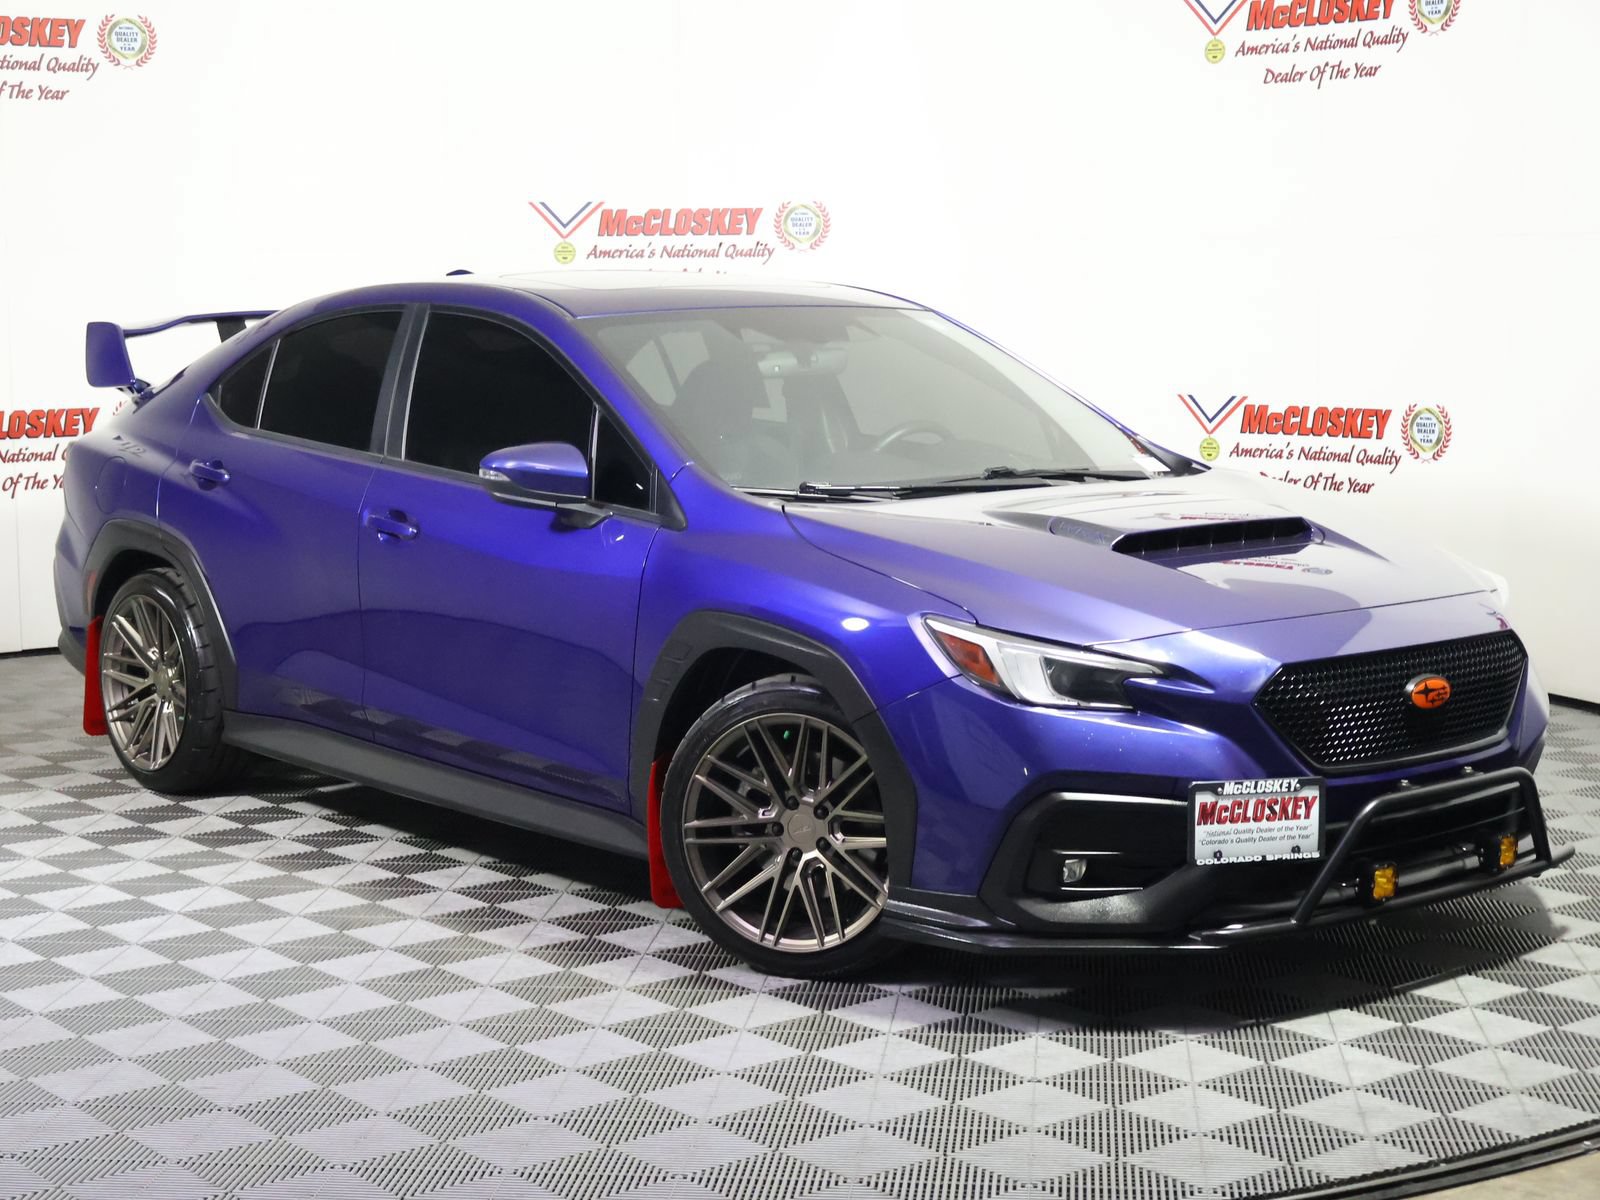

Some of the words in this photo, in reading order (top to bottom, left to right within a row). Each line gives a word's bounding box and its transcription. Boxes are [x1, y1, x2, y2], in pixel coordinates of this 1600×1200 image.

[1235, 35, 1300, 57] America's
[1304, 29, 1361, 53] National
[1363, 25, 1410, 53] Quality
[46, 54, 100, 81] Quality
[1263, 64, 1307, 84] Dealer
[1310, 61, 1329, 89] Of
[1329, 60, 1351, 80] The
[1354, 62, 1382, 79] Year
[8, 81, 34, 100] The
[37, 84, 70, 101] Year
[597, 207, 763, 237] McCLOSKEY
[586, 242, 656, 260] America's
[660, 241, 723, 259] National
[724, 242, 776, 265] Quality
[1240, 404, 1392, 440] McCLOSKEY
[1229, 441, 1294, 461] America's
[1298, 445, 1353, 465] National
[1355, 447, 1402, 474] Quality
[2, 472, 23, 499] Of
[23, 472, 49, 491] The
[1303, 471, 1323, 491] Of
[1322, 473, 1344, 492] The
[1347, 476, 1375, 494] Year
[1223, 779, 1299, 795] McCLOSKEY
[1197, 796, 1318, 826] McCLOSKEY
[1235, 836, 1257, 844] Quality
[1196, 854, 1263, 866] COLORADO
[1265, 851, 1320, 862] SPRINGS
